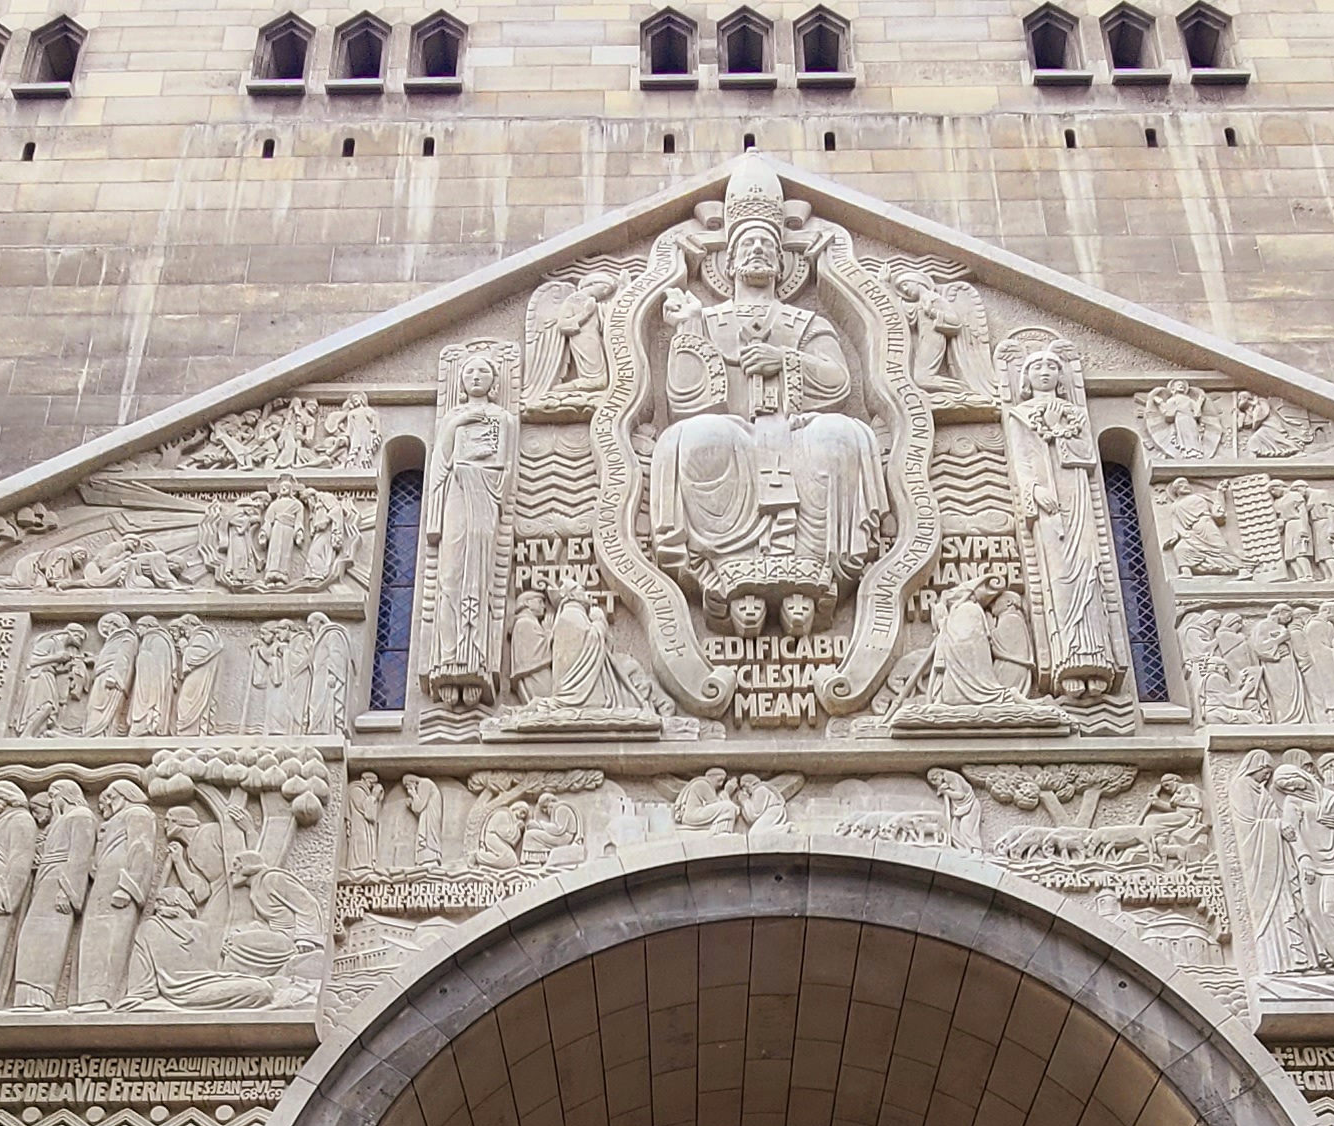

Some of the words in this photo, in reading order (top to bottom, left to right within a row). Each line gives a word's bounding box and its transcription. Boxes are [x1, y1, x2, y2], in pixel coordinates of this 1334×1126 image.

[568, 538, 593, 560] ES
[942, 537, 1020, 559] SVPER
[516, 565, 600, 590] PETRVS
[735, 692, 817, 718] MEAM
[79, 1055, 167, 1078] SEIGNEUR
[200, 1057, 261, 1077] IRIONS
[260, 1056, 306, 1076] NOUS
[73, 1078, 109, 1102] VIE
[109, 1078, 205, 1101] ETERNELLE
